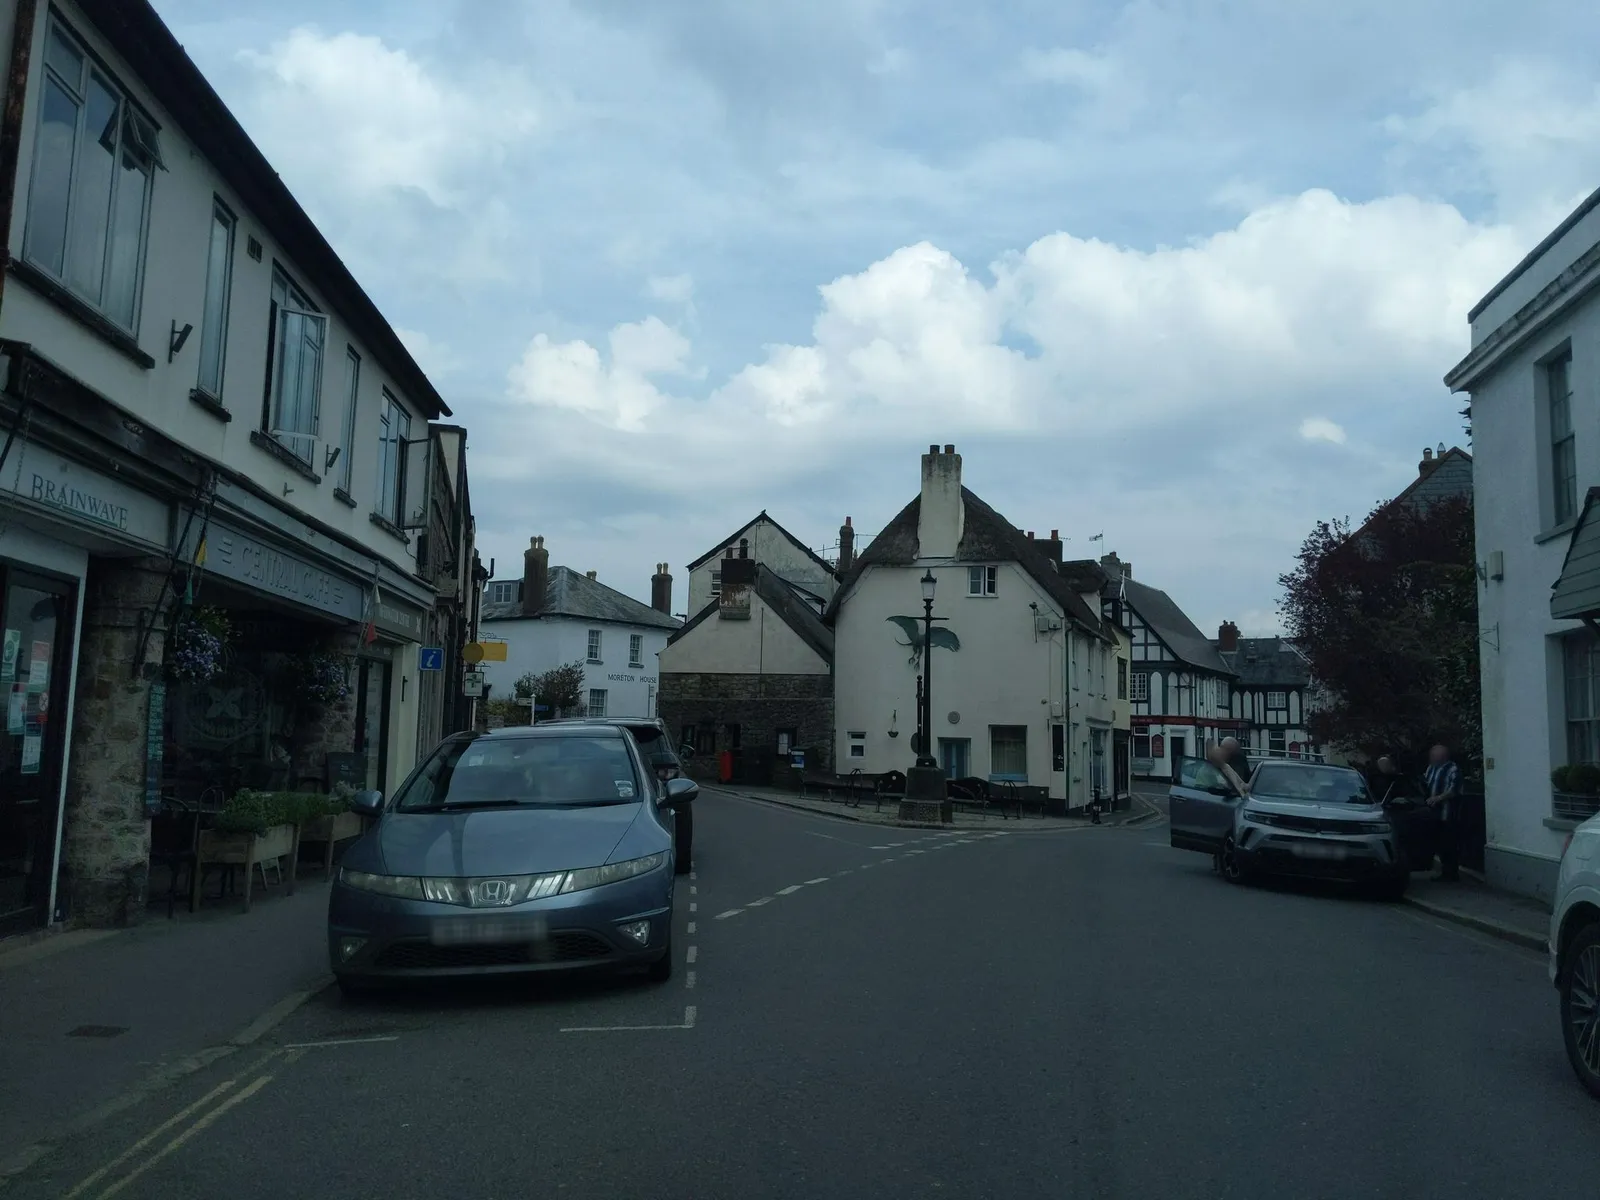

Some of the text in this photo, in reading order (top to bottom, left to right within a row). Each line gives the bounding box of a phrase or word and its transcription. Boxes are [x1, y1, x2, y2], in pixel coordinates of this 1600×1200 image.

[241, 545, 299, 595] CENTRAL
[607, 673, 657, 684] MORETON HOUSE
